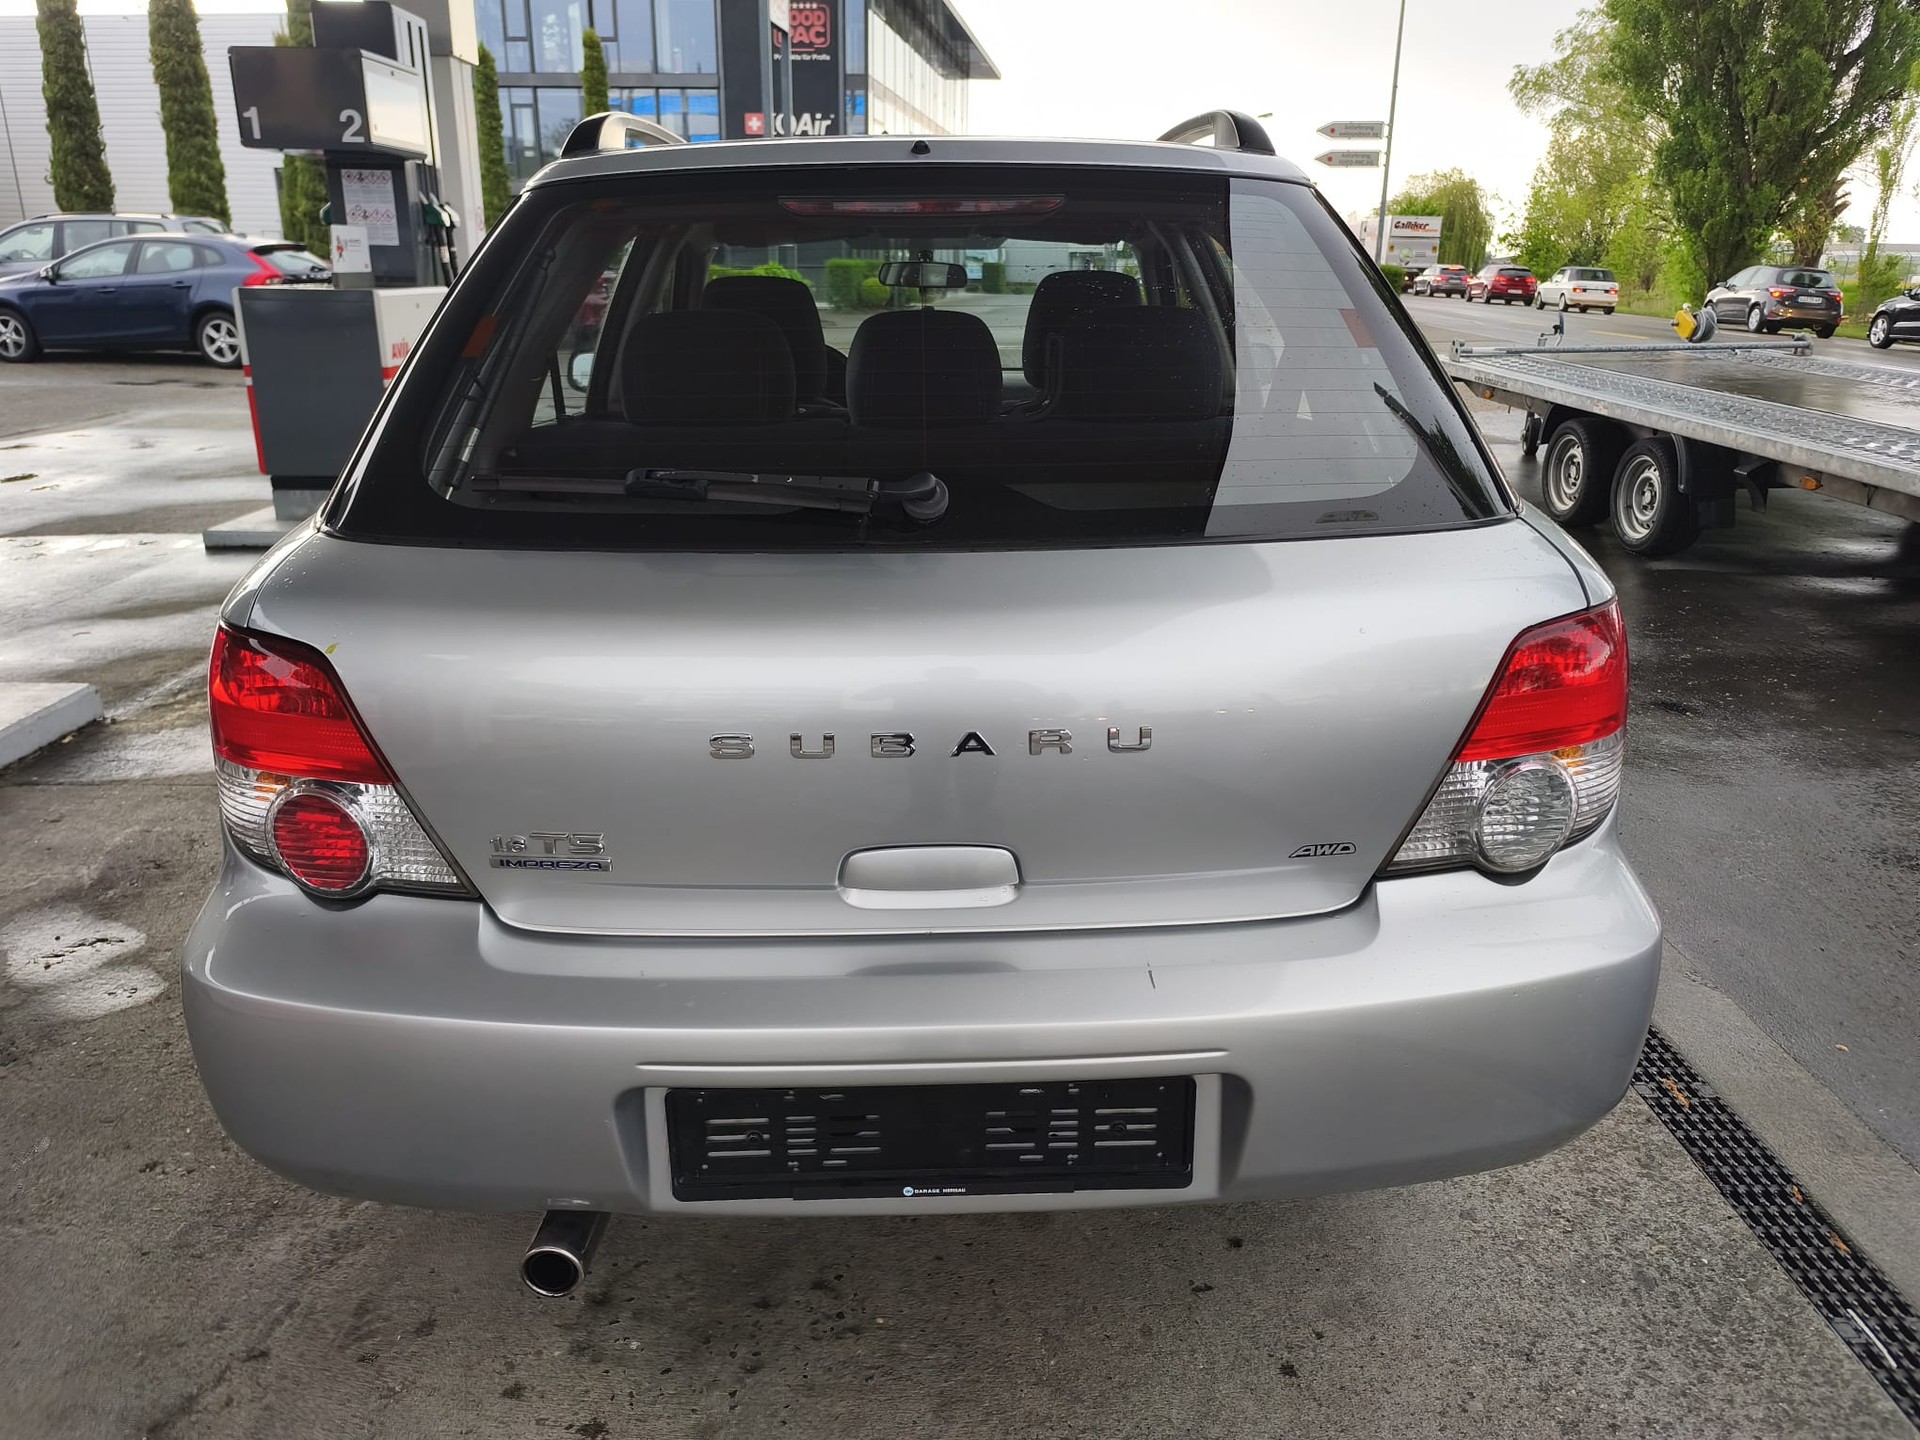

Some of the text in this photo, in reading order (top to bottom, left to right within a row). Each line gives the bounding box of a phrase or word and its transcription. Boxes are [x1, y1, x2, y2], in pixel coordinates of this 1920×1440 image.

[790, 10, 825, 26] OOD
[242, 106, 262, 139] 1
[339, 108, 365, 143] 2
[709, 726, 1152, 760] SUBARU
[529, 830, 605, 854] TS
[1289, 842, 1356, 858] AWD
[499, 859, 603, 870] IMPREZA
